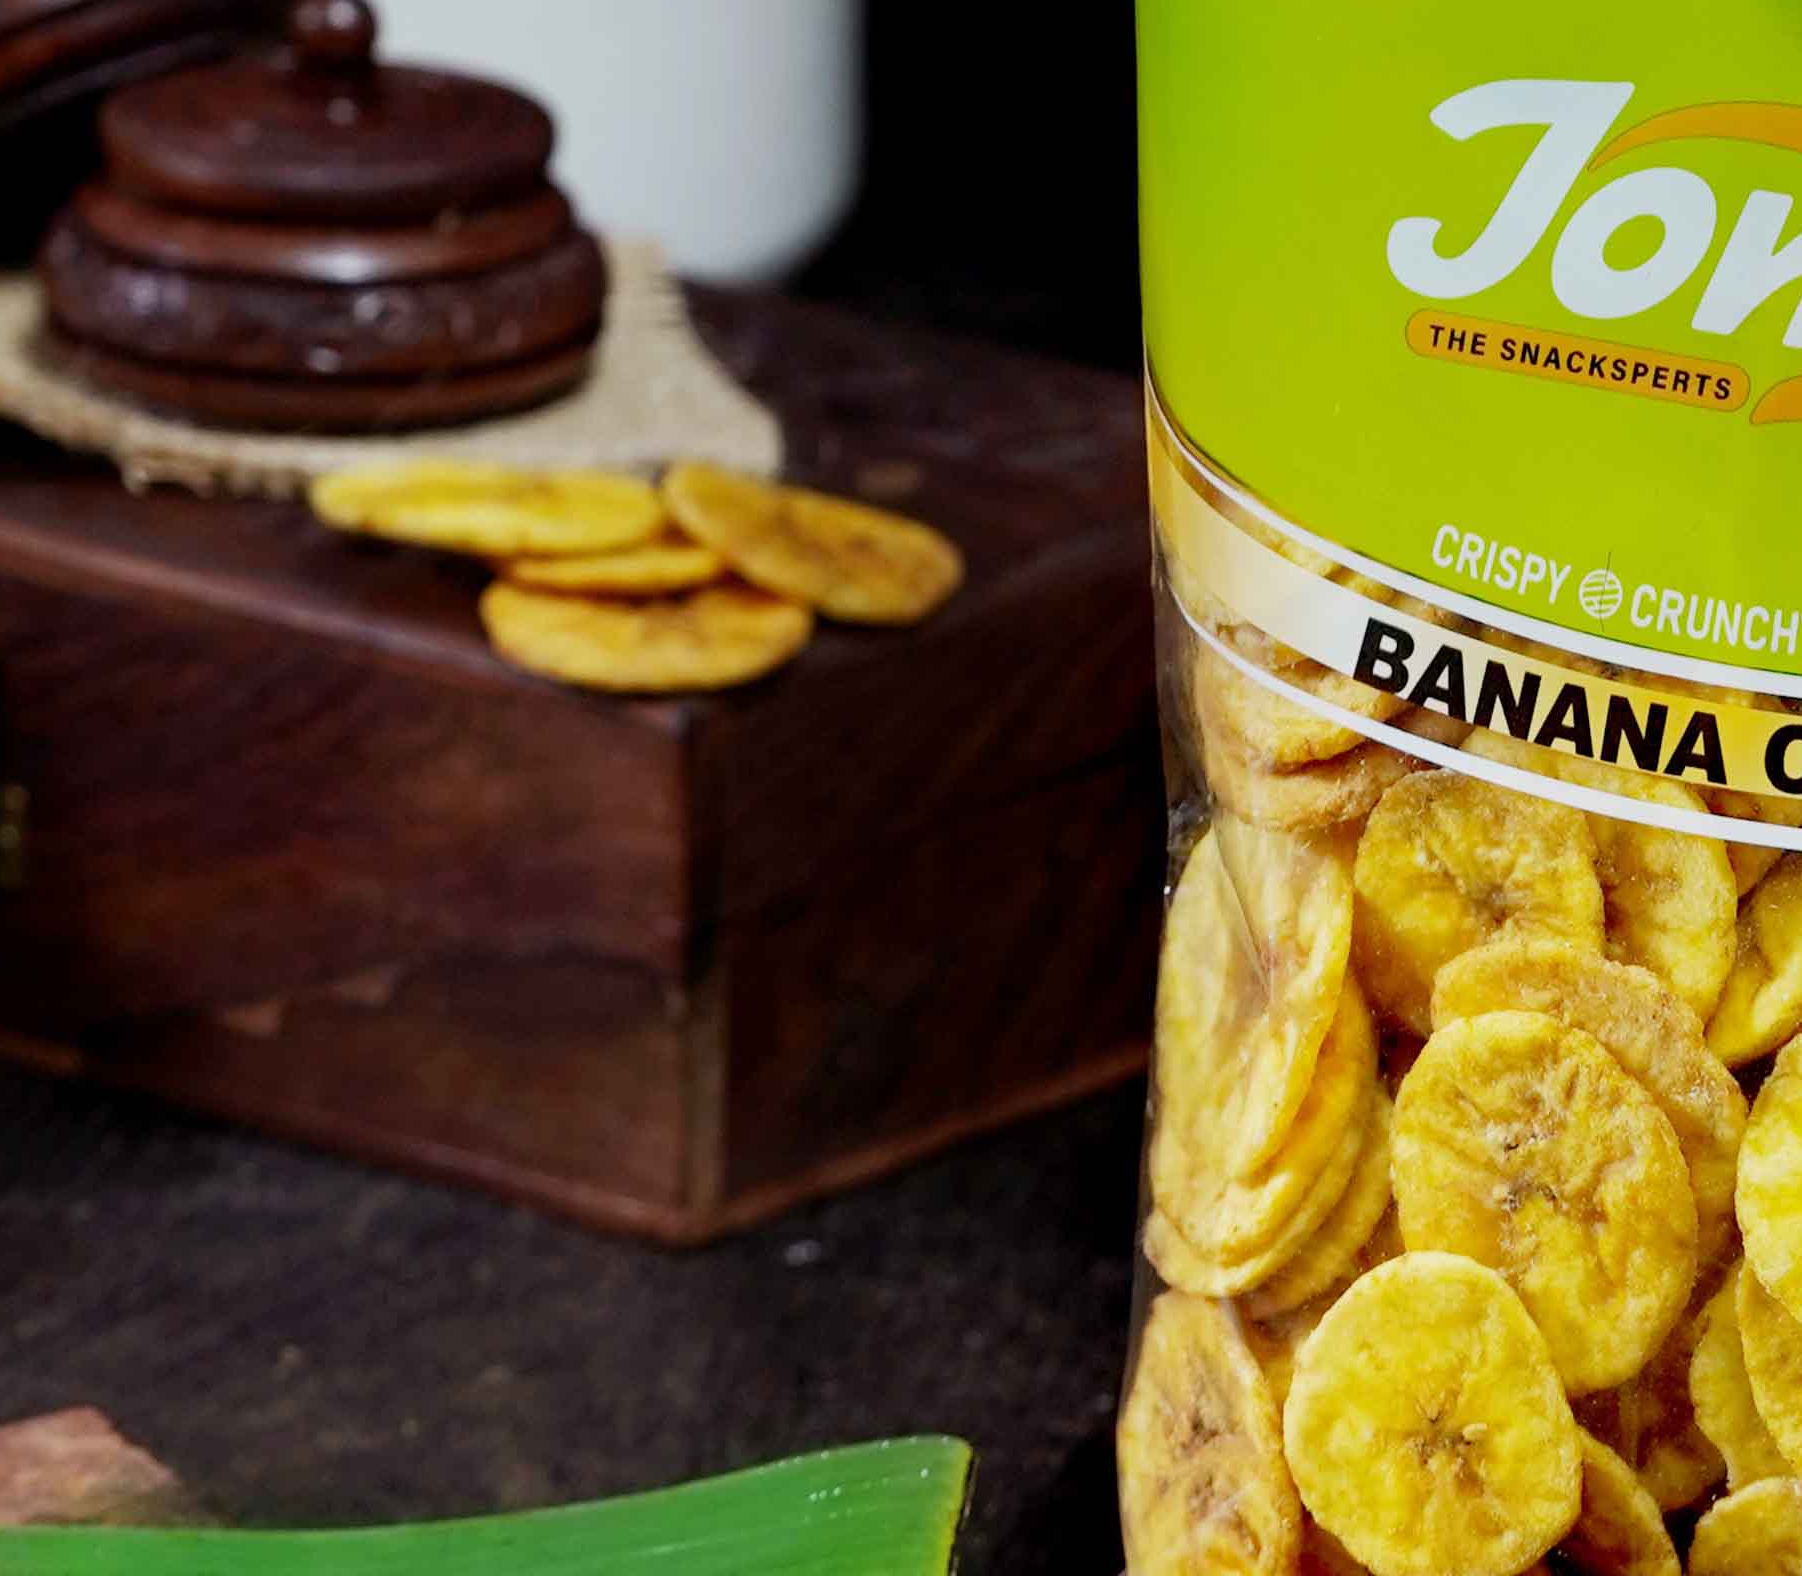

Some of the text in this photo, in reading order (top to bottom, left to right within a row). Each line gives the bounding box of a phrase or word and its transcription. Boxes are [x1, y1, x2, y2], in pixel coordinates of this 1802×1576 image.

[1428, 324, 1733, 401] THE SNACKSPERTS
[1431, 524, 1571, 605] CRISPY
[1352, 617, 1728, 785] BANANA
